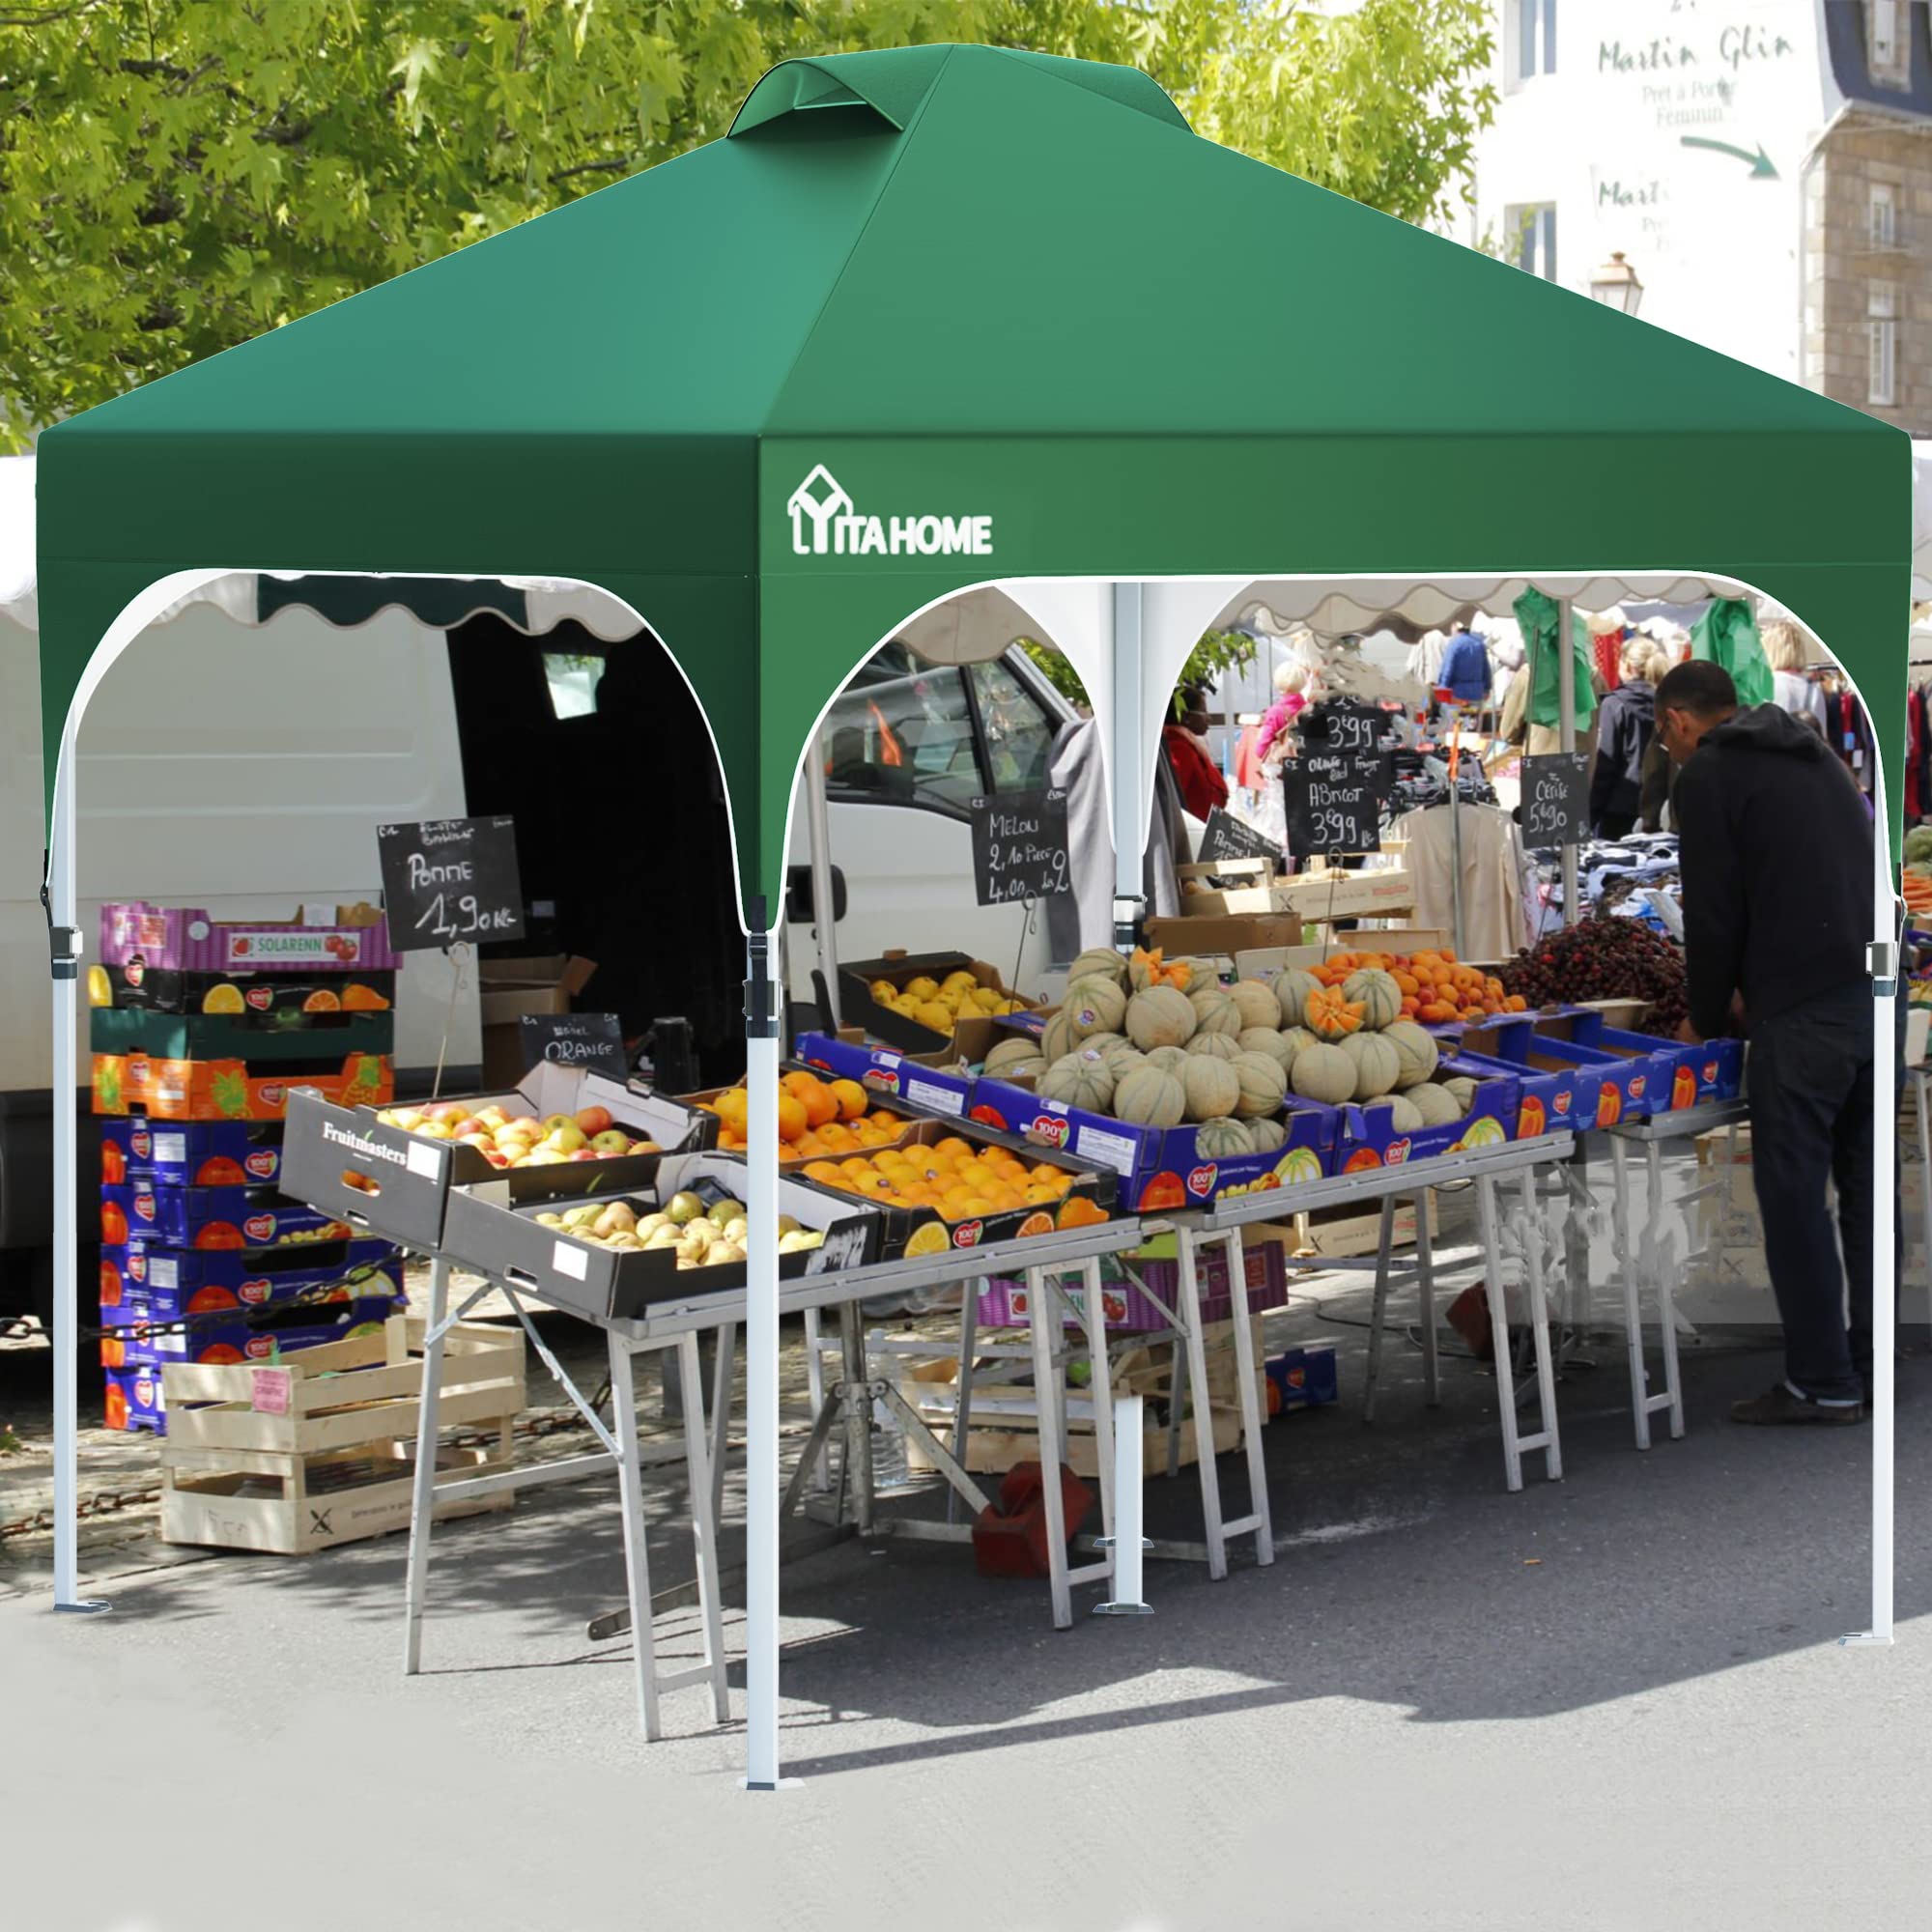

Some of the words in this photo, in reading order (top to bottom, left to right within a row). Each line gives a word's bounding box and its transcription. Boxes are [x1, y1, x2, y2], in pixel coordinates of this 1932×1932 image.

[1598, 35, 1699, 73] Martin
[1691, 79, 1736, 99] Porr
[258, 937, 322, 952] SOLARENN
[322, 1122, 407, 1165] Fruitmasters
